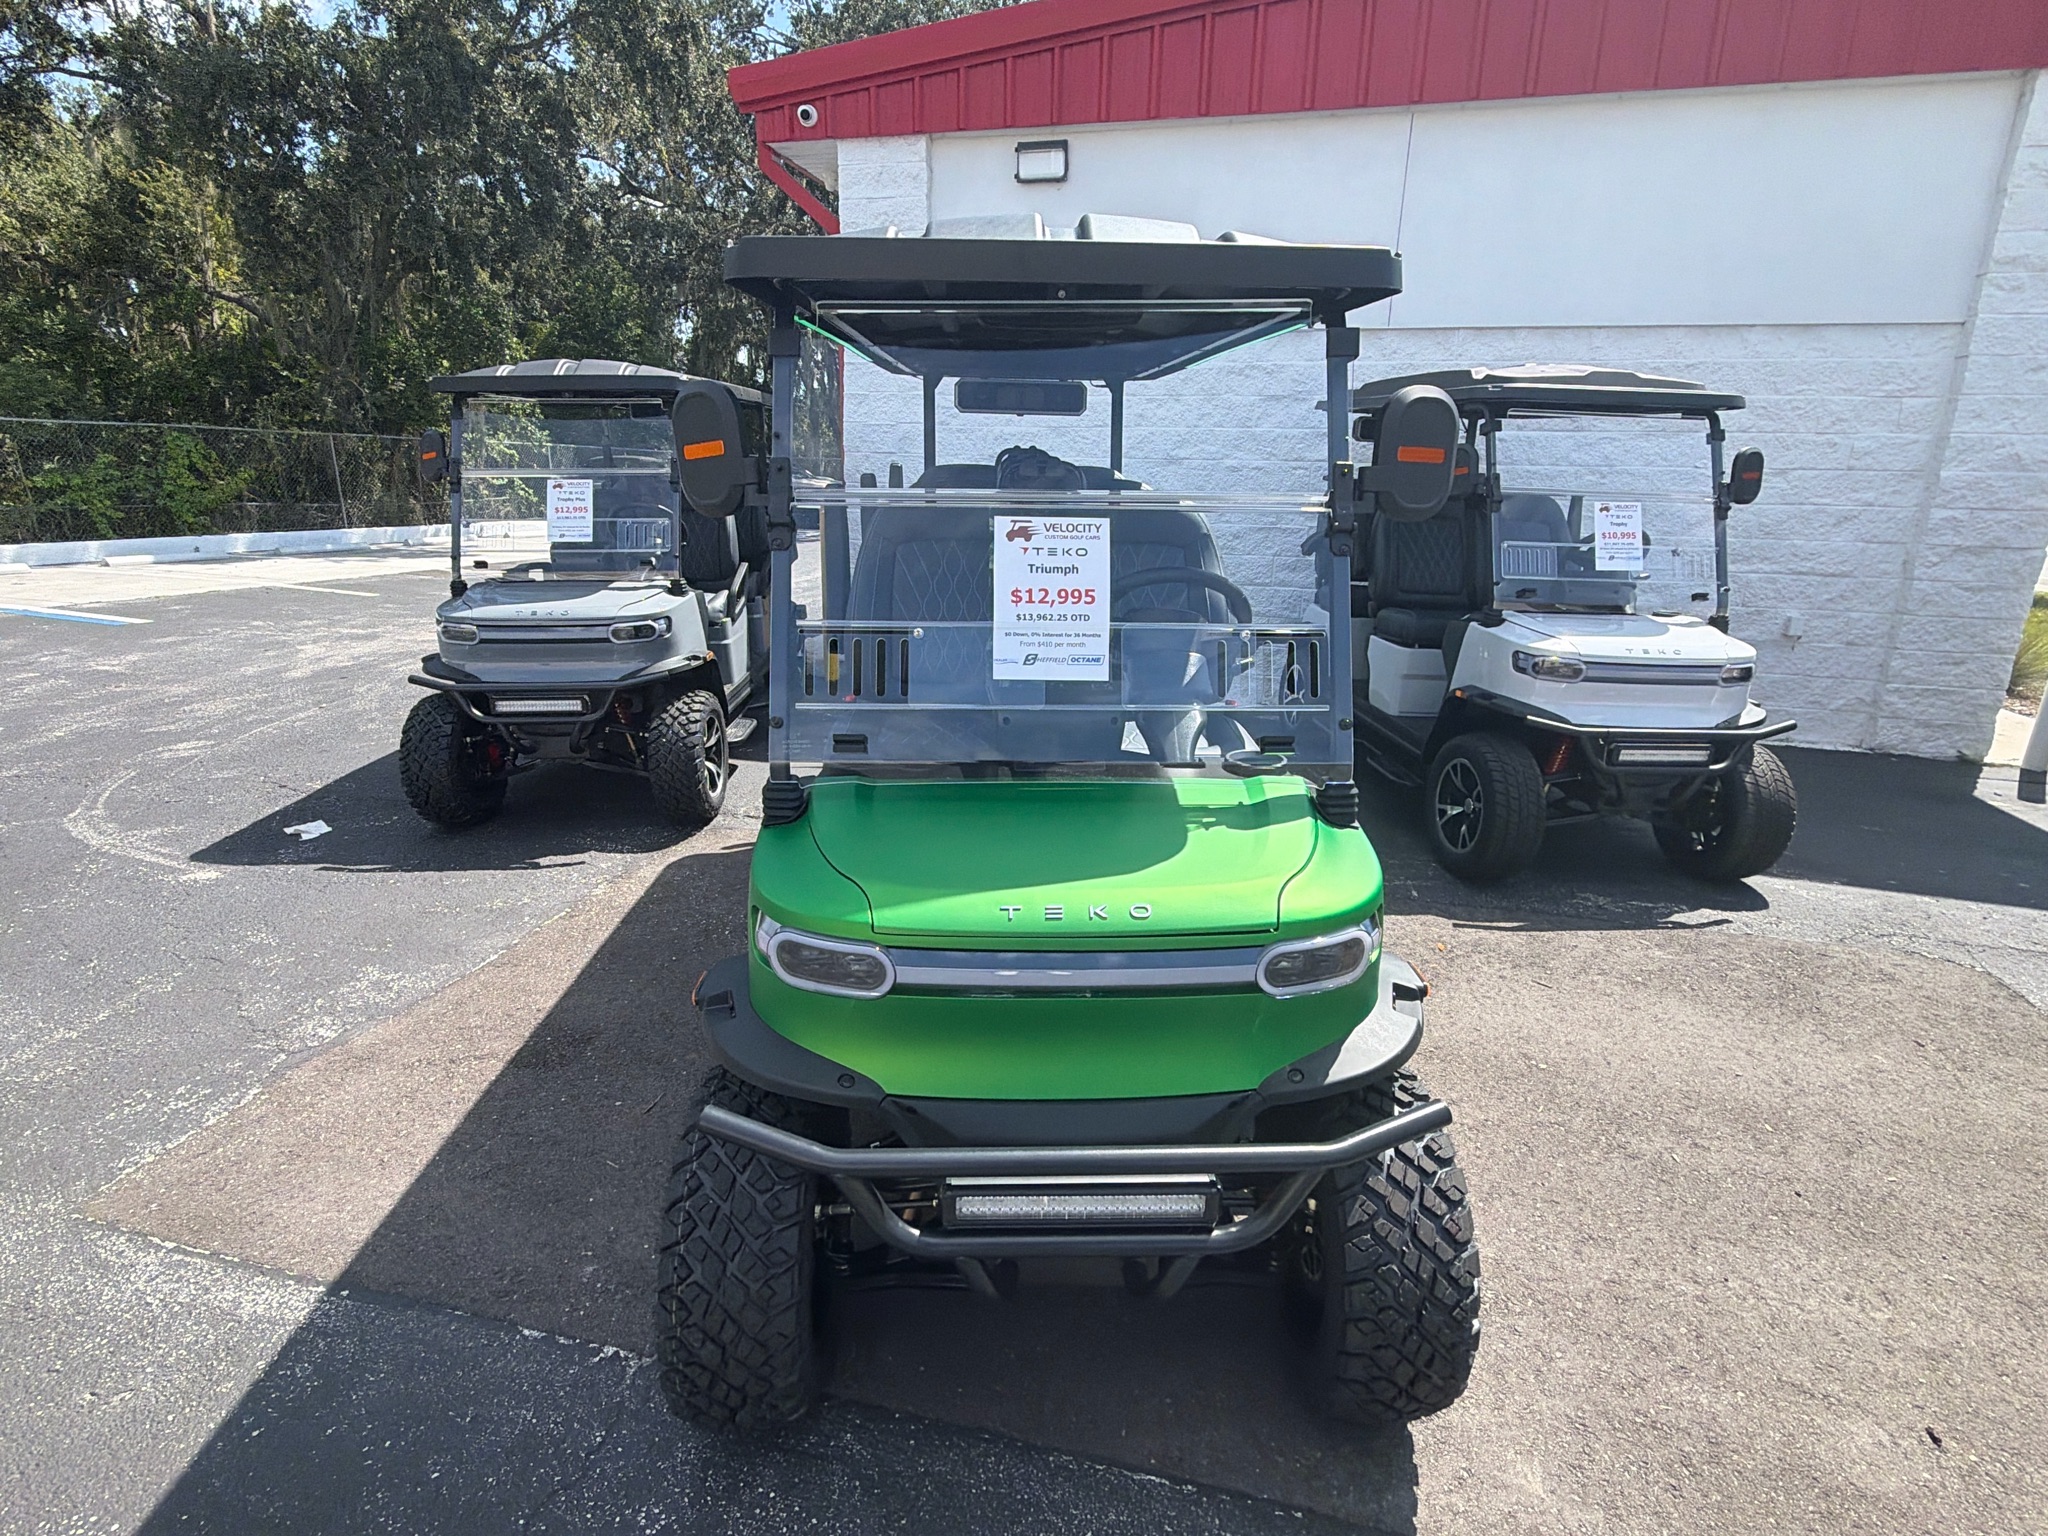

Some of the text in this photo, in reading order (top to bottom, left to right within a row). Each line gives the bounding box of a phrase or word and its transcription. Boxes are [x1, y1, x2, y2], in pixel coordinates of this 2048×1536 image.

[554, 506, 588, 514] $12,995
[1044, 522, 1102, 533] VELOCITY
[1602, 532, 1636, 540] $10,995
[1032, 547, 1088, 557] TEKO
[1028, 564, 1079, 576] Triumph
[1011, 587, 1096, 608] $12,995
[1016, 613, 1068, 622] $13,962.25
[1022, 654, 1066, 665] SHEFFIELD
[999, 904, 1152, 922] TEKO
